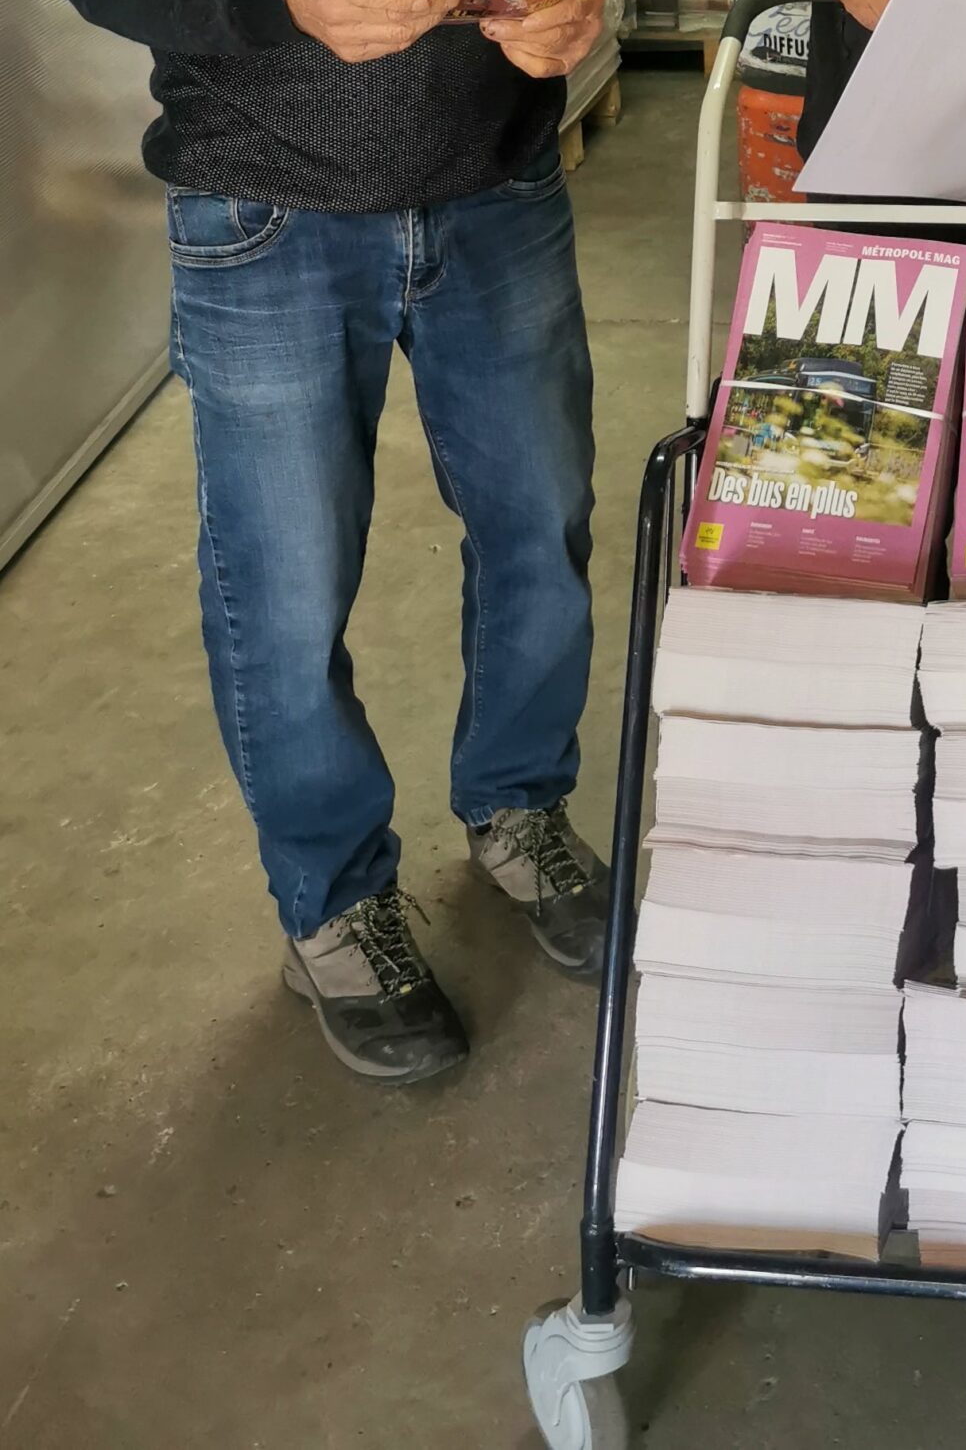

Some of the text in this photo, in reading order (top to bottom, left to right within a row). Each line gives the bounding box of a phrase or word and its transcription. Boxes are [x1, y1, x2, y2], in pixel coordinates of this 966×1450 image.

[763, 34, 810, 57] DIFFU
[861, 244, 932, 261] MÉTROPOLE
[932, 253, 961, 265] MAG
[743, 246, 959, 358] MM
[708, 467, 858, 519] Des bus en plus
